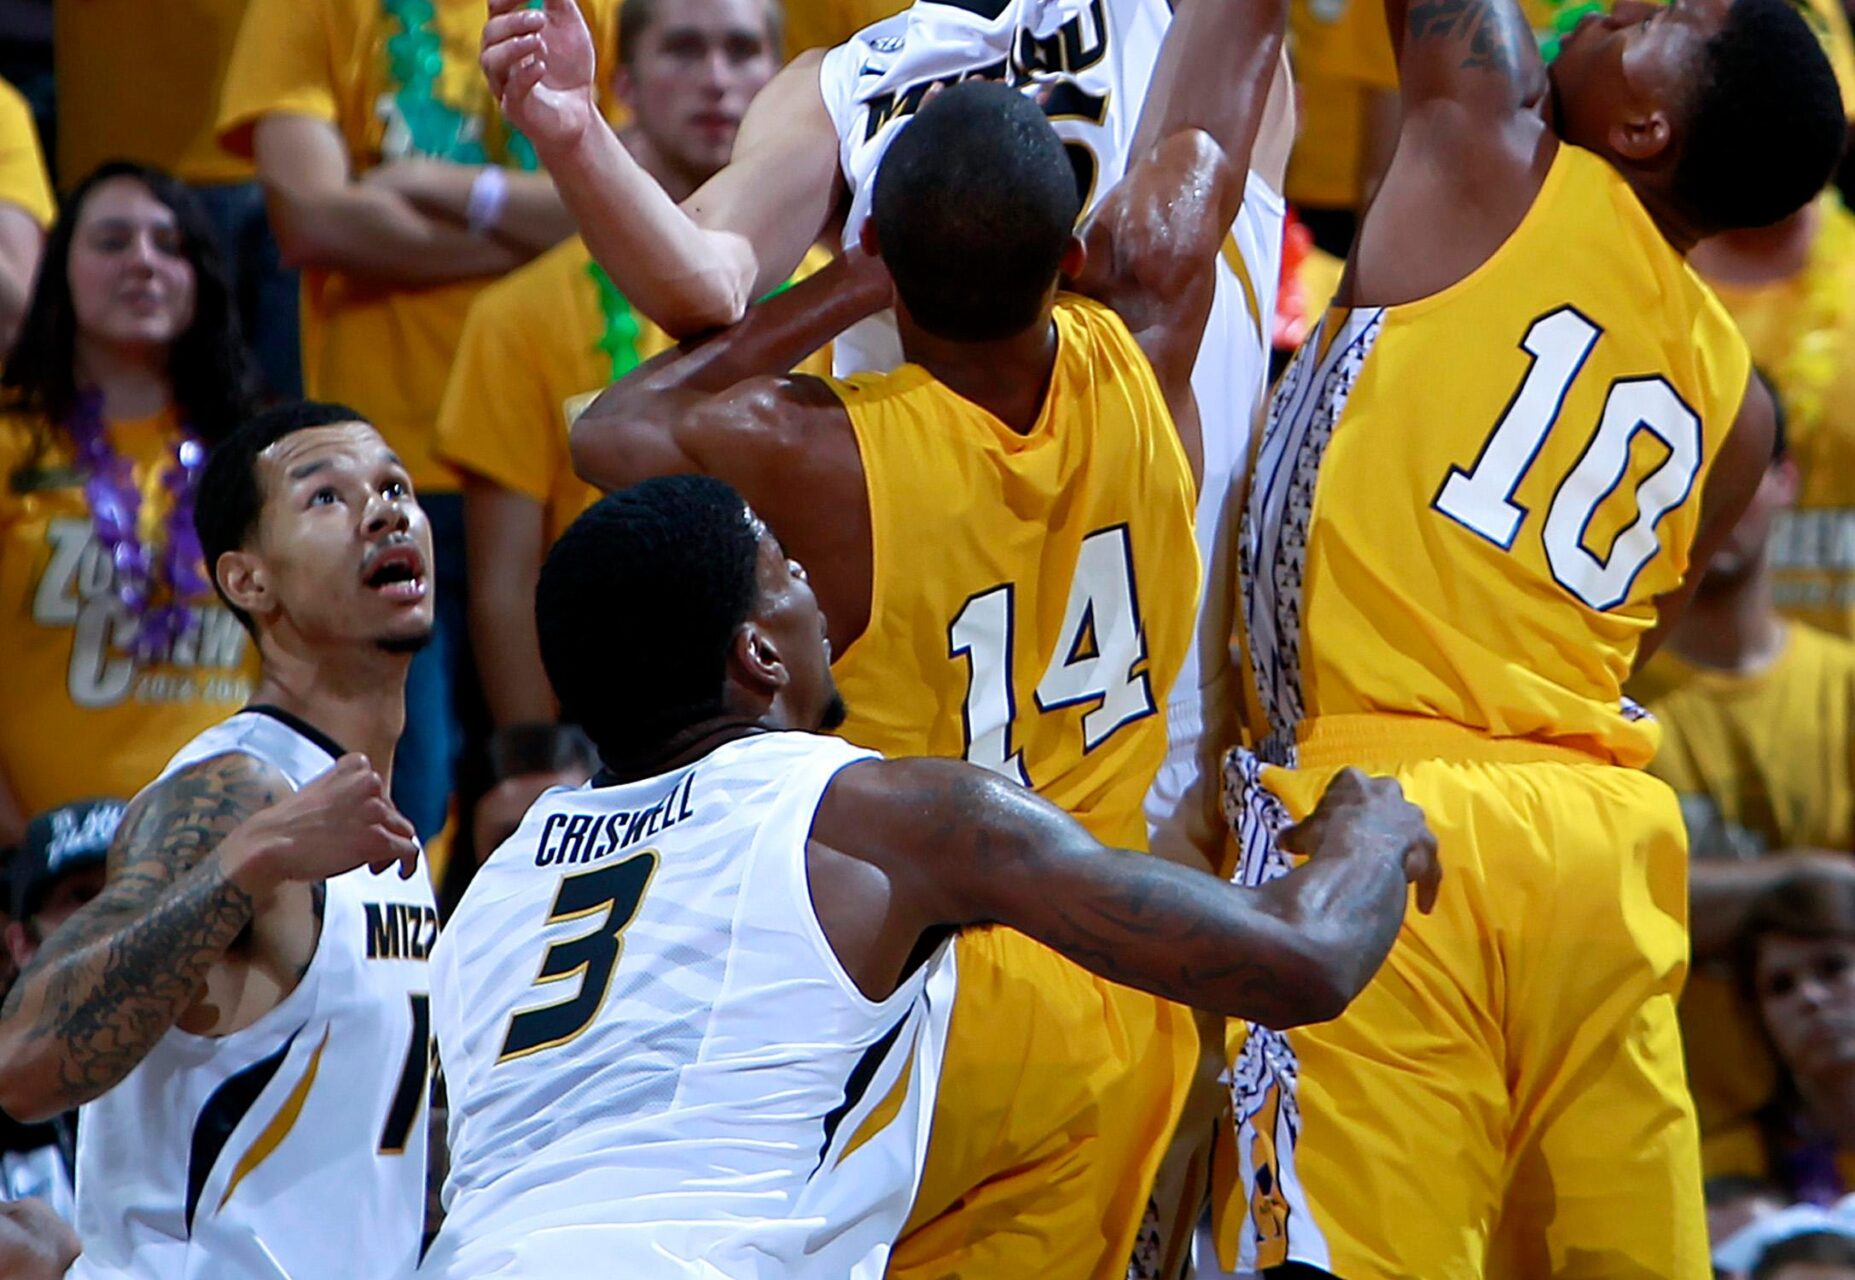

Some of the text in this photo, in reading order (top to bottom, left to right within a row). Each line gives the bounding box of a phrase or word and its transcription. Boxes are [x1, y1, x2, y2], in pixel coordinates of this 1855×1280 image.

[1431, 303, 1703, 611] 10
[947, 521, 1158, 788] 14
[496, 848, 661, 1066] 3
